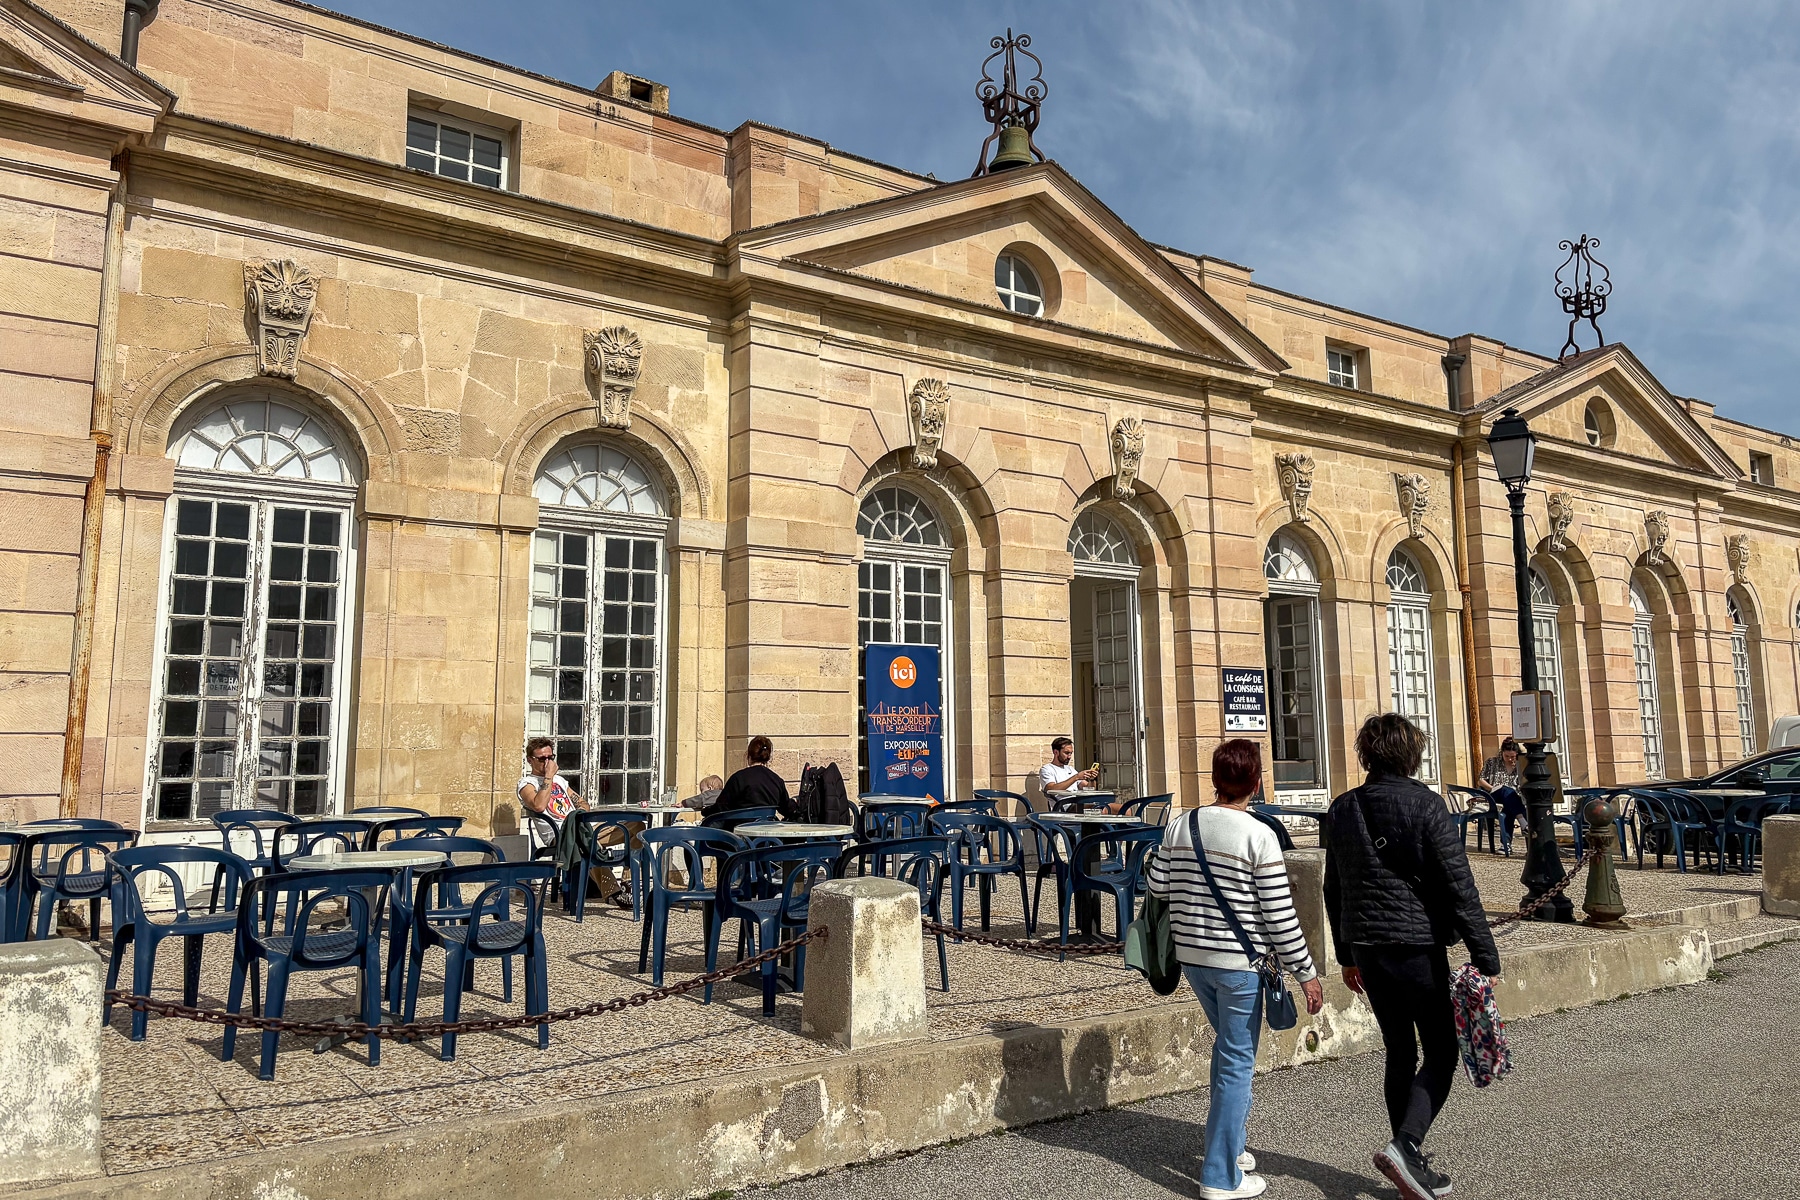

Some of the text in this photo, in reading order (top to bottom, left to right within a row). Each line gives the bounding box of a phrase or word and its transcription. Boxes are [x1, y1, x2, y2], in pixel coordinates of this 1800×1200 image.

[892, 663, 914, 680] ici
[1226, 673, 1262, 684] LE café DE
[1224, 684, 1264, 693] LA CONSIGNE
[887, 706, 920, 715] LE PONT
[872, 716, 932, 726] TRANSBORDEUR
[884, 740, 928, 750] EXPOSITION
